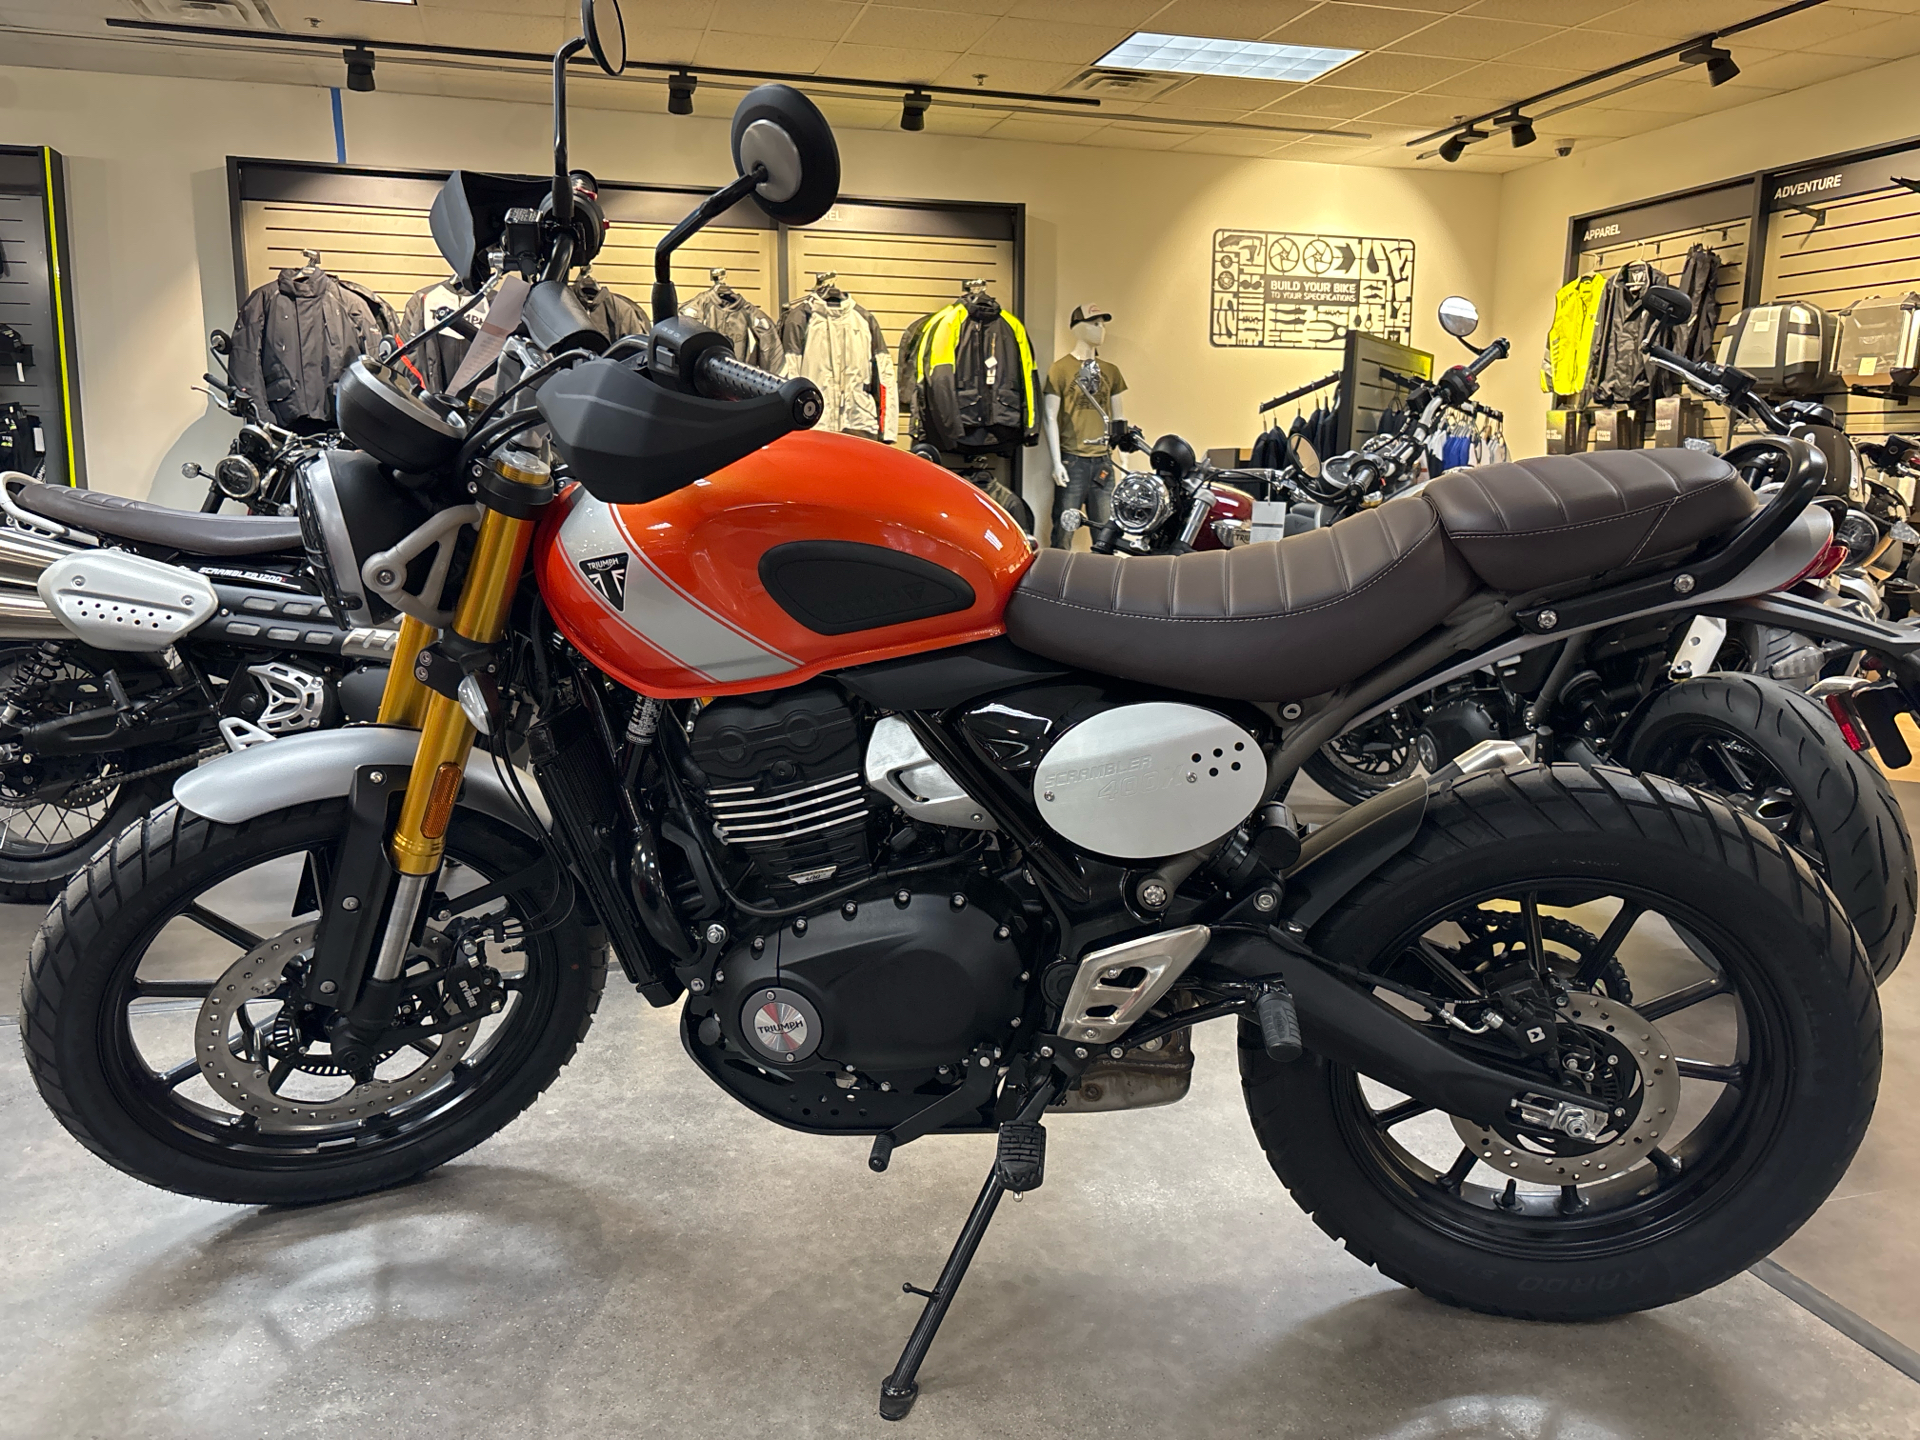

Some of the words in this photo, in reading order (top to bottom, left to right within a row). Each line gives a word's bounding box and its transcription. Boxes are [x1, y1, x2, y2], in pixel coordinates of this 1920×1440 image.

[1774, 174, 1843, 200] ADVENTURE
[1584, 224, 1621, 241] APPAREL
[1270, 280, 1300, 291] BUILD
[1303, 281, 1331, 292] YOUR
[1333, 283, 1356, 293] BIKE
[1271, 291, 1280, 299] TO
[1283, 291, 1302, 300] YOUR
[1303, 292, 1356, 302] SPECIFICATIONS
[587, 557, 619, 571] TRIUMPH
[198, 566, 257, 579] SCRAMBLER
[1044, 754, 1152, 788] SCRAMBLER
[458, 980, 477, 1008] BYBRE
[757, 1020, 804, 1034] TRIUMPH
